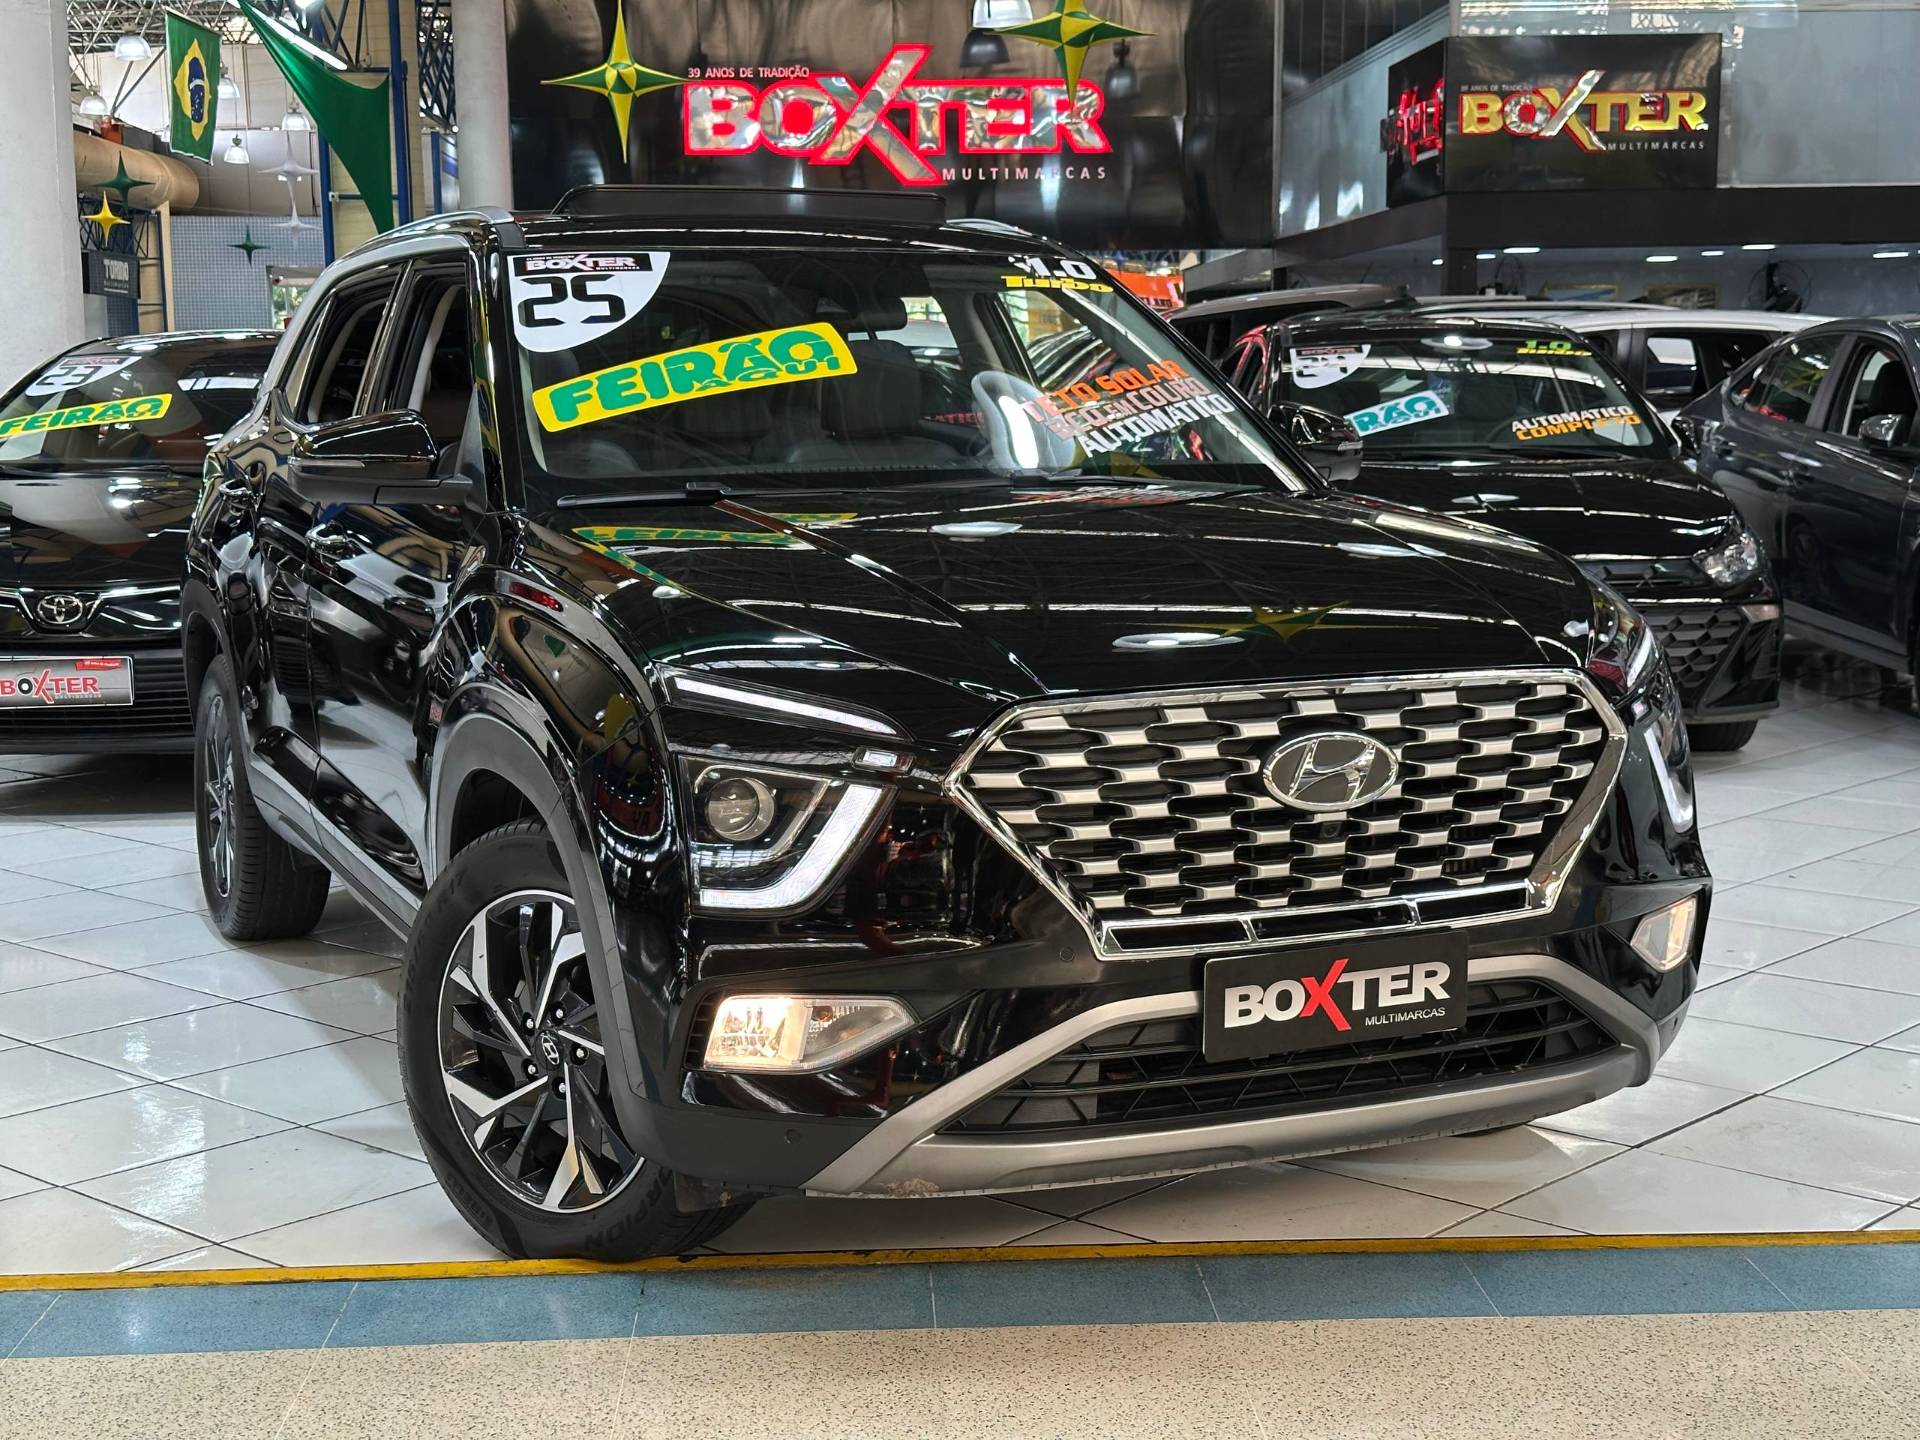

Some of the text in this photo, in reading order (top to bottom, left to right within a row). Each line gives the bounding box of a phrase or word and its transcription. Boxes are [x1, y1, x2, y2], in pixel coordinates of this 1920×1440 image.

[688, 64, 810, 80] 39 ANOS DE TRADIÇÃO
[684, 43, 1113, 186] BOXTER
[1459, 69, 1709, 153] BOXTER
[1606, 141, 1705, 151] MULTIMARCAS
[941, 166, 1107, 181] MULTIMARCAS
[525, 254, 637, 271] BOXTER
[517, 274, 626, 328] 25
[1000, 275, 1115, 293] Turbo
[549, 330, 835, 422] FEIRÃO
[1023, 359, 1189, 422] TETO SOLAR
[1126, 376, 1211, 411] COURO
[0, 397, 163, 434] FEIRÃO
[0, 669, 100, 704] BOXTER
[1224, 958, 1452, 1031] BOXTER
[1364, 1007, 1446, 1027] MULTIMARCAS
